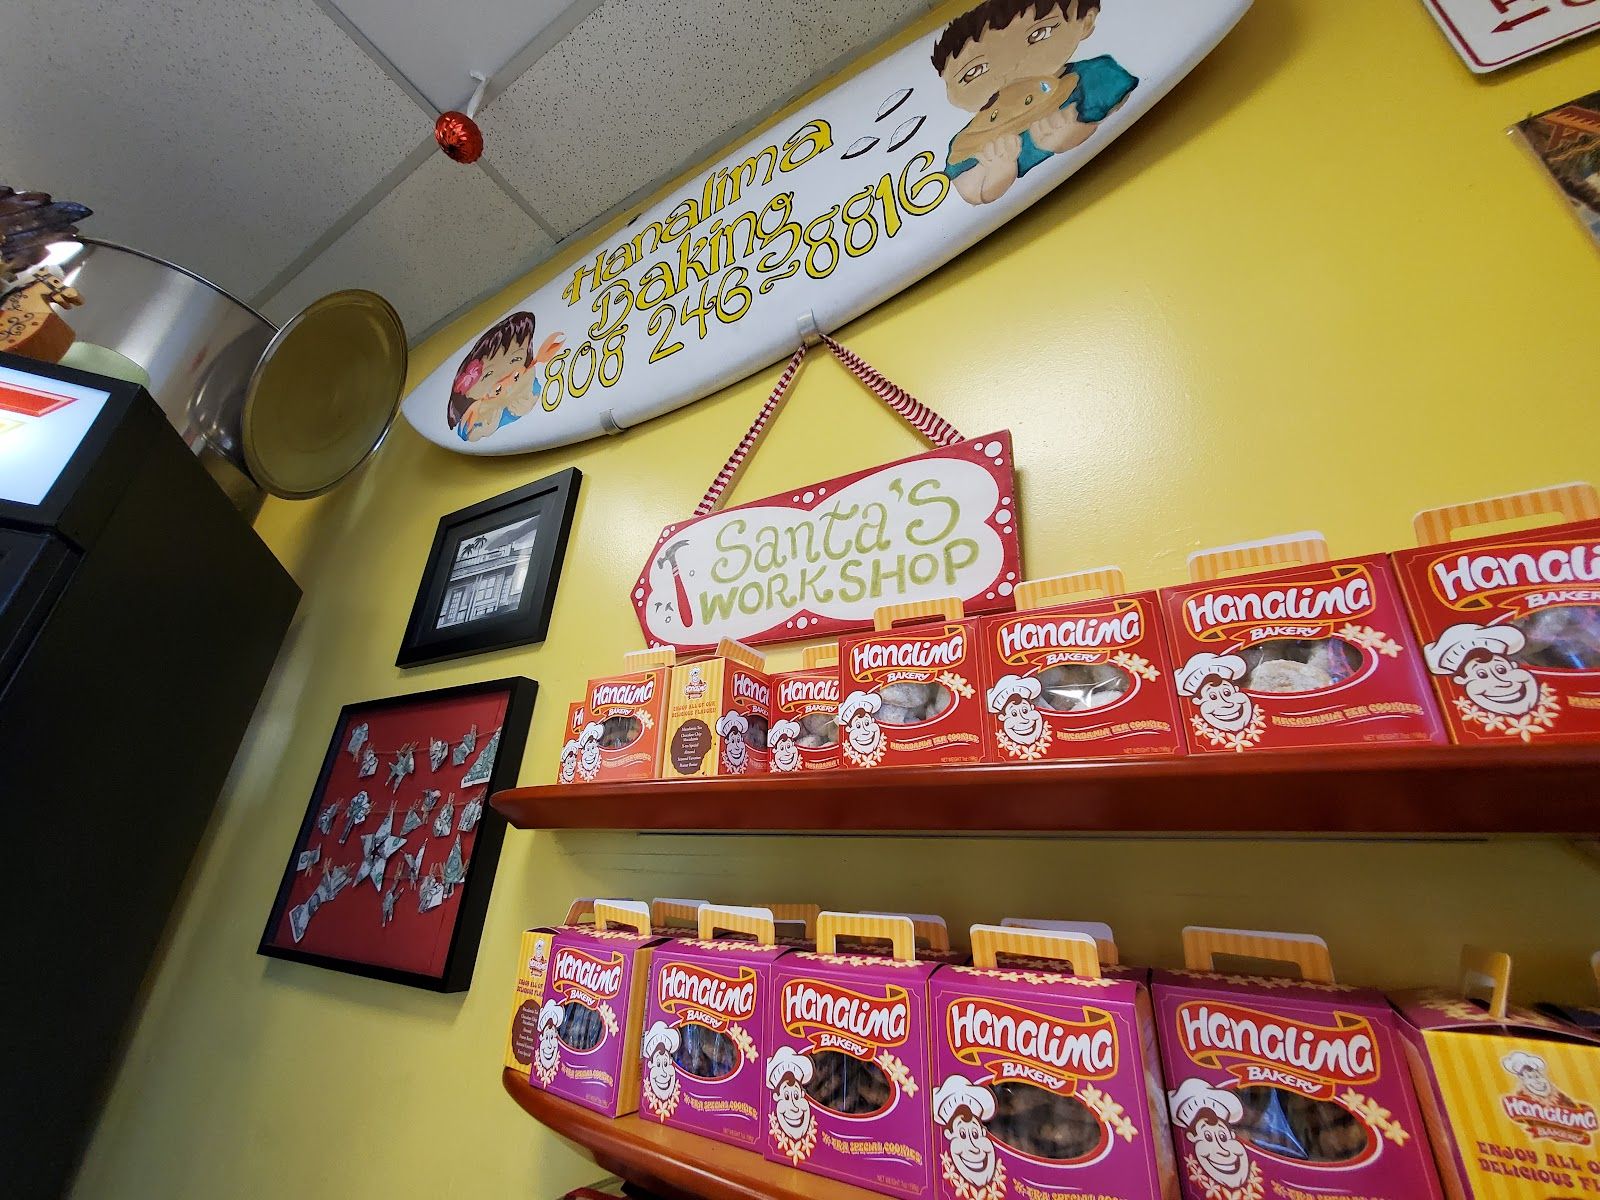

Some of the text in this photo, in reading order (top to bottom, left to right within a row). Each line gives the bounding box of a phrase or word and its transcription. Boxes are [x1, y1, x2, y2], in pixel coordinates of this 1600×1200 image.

[562, 119, 833, 306] Hanalima
[588, 192, 800, 340] Baking
[541, 325, 628, 411] 808
[1434, 545, 1600, 600] Hanali
[1187, 578, 1370, 632] Hanalima
[1525, 590, 1600, 608] BAKER
[1000, 612, 1140, 656] Hanalima
[1249, 626, 1321, 640] BAKERY
[853, 636, 964, 674] Hanalima
[1046, 653, 1101, 665] BAKERY
[734, 673, 769, 706] Hanal
[887, 671, 930, 681] BAKERY
[593, 681, 653, 709] Hanalima
[780, 680, 839, 706] Hanali
[804, 704, 837, 713] BAKERY
[556, 952, 620, 994] Hanalima
[569, 989, 597, 1005] BAKERY
[661, 966, 754, 1014] Hanalima
[686, 1010, 723, 1028] BAKERY
[786, 984, 907, 1040] Hanalima
[820, 1034, 868, 1055] BAKERY
[952, 1003, 1113, 1073] Hanalima
[1181, 1006, 1374, 1077] Hanalima
[1001, 1063, 1066, 1090] BAKERY
[1247, 1066, 1323, 1094] BAKERY
[1504, 1097, 1598, 1129] Hanalima
[1476, 1141, 1537, 1164] ENJOY
[1545, 1153, 1582, 1172] ALL
[1477, 1159, 1574, 1188] DELICIOUS
